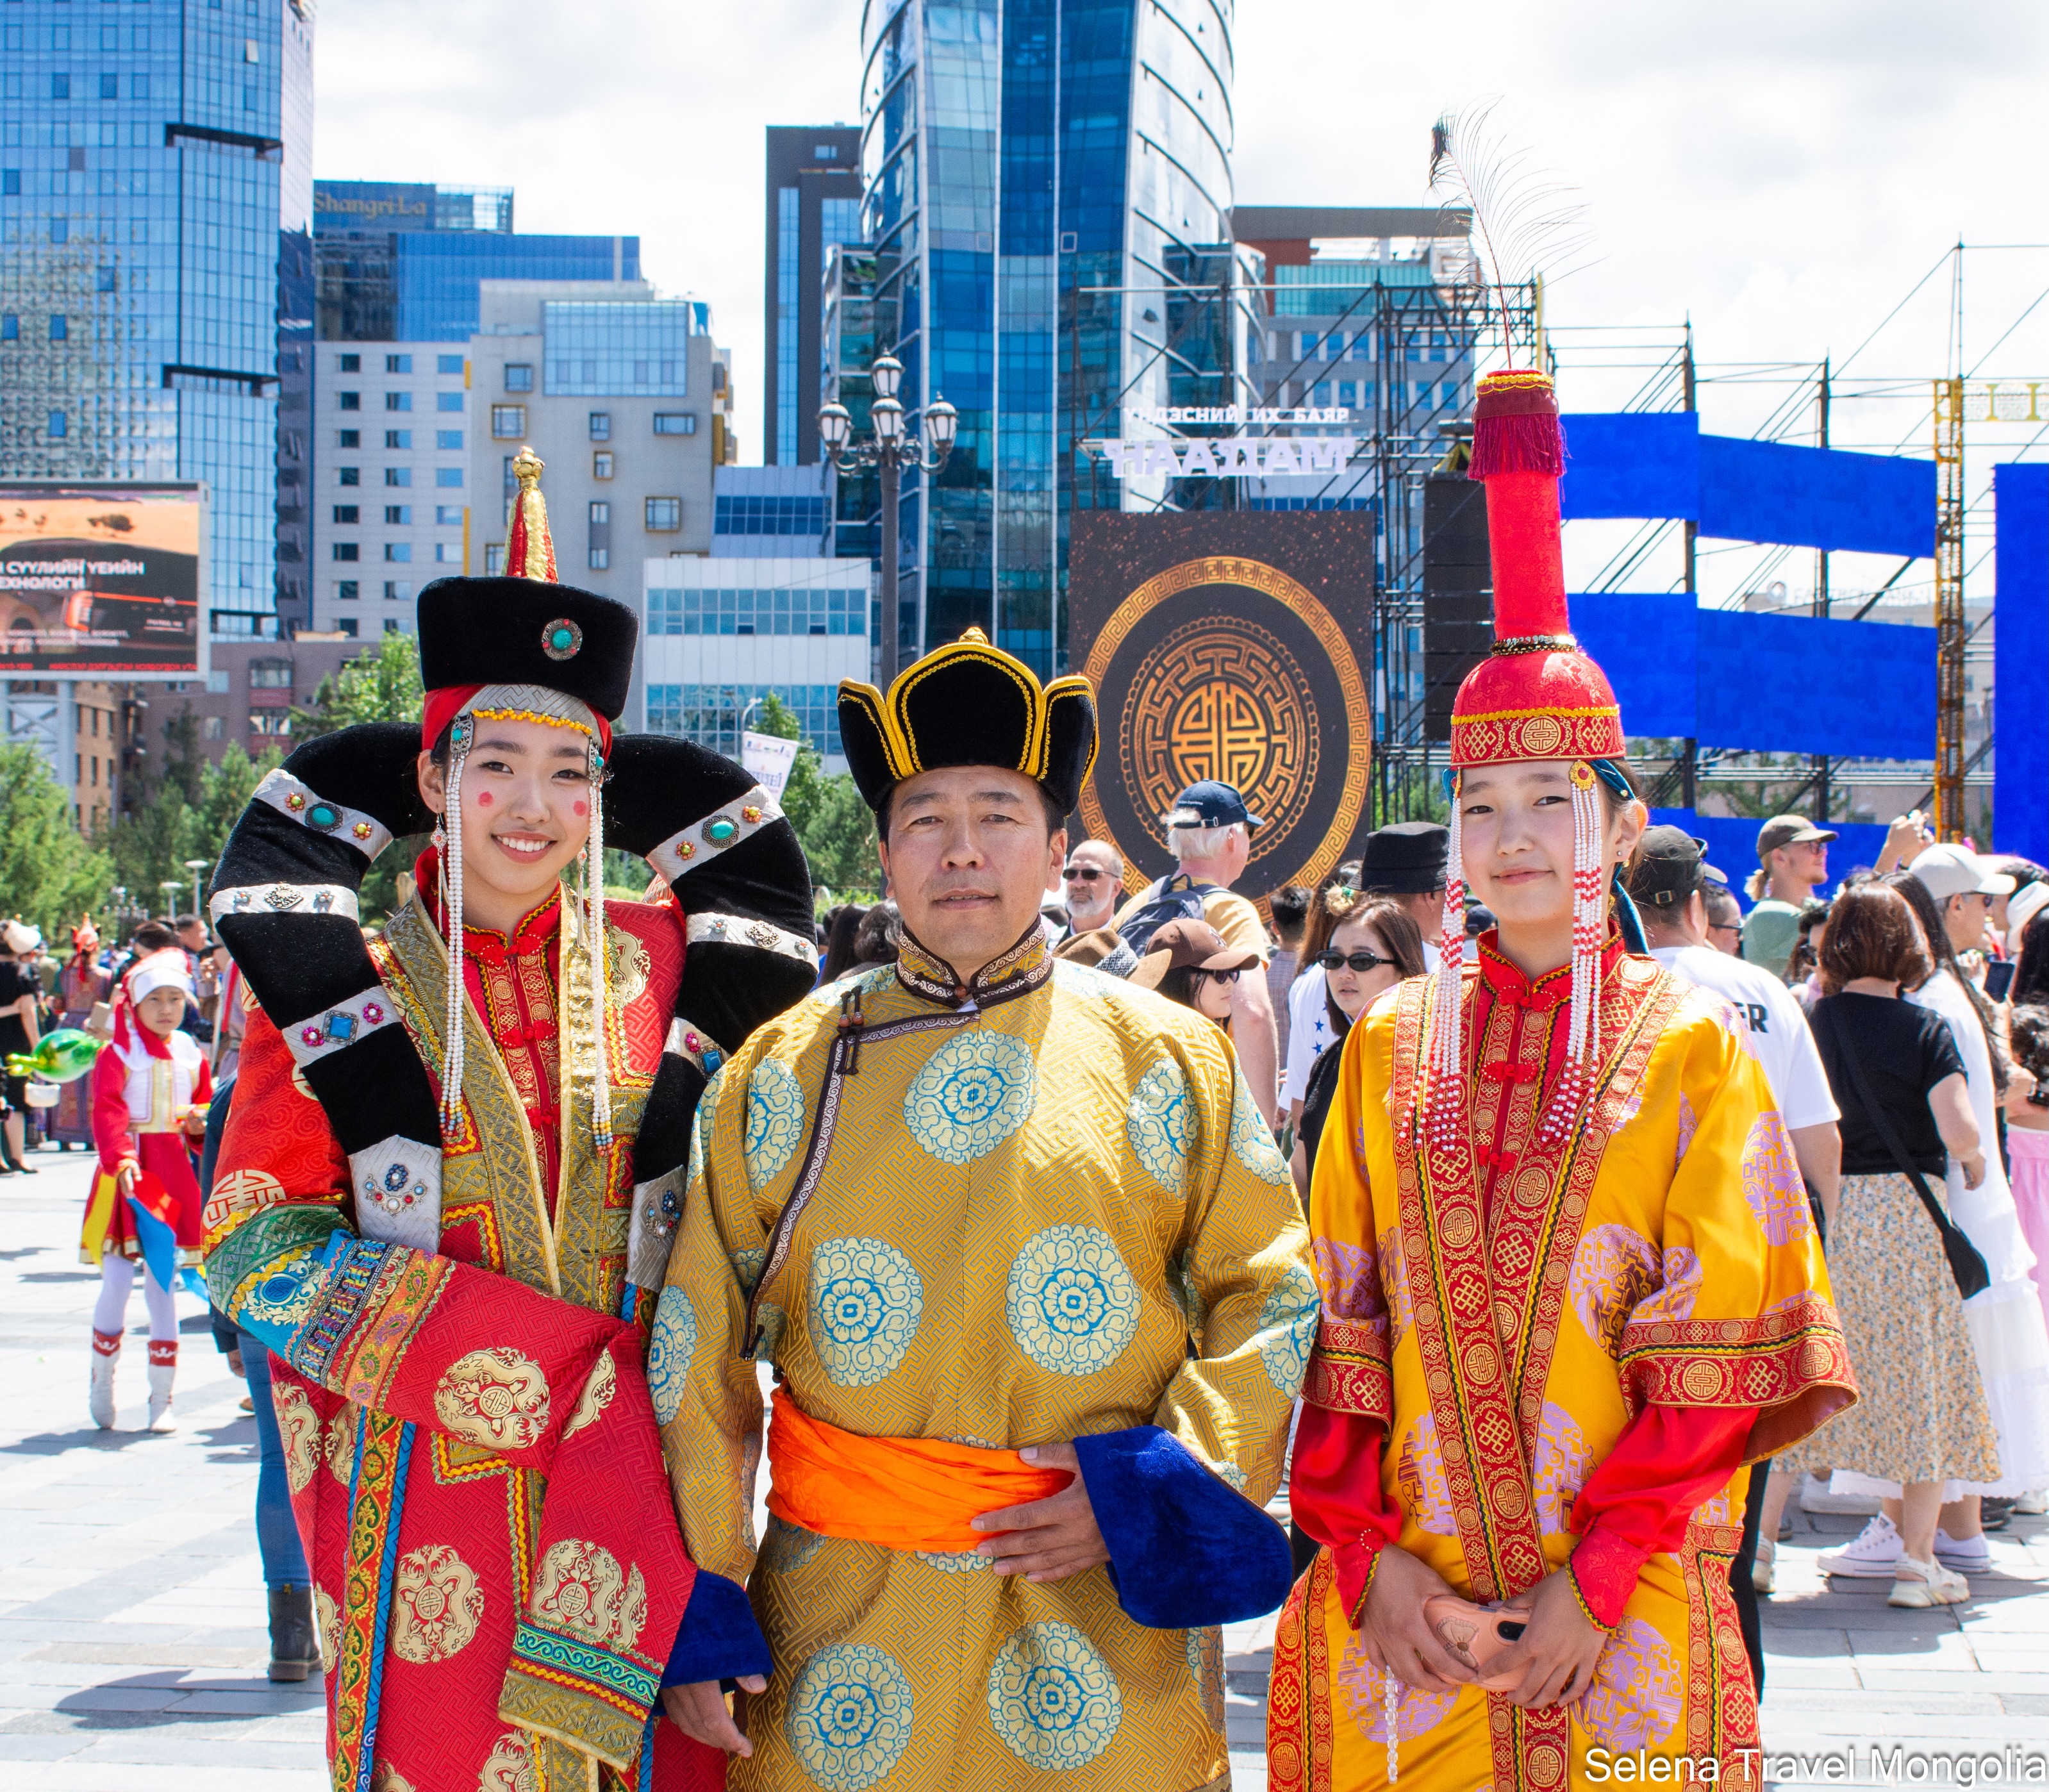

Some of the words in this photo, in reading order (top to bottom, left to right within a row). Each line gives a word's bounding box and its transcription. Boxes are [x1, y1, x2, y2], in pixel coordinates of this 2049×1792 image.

[1252, 408, 1282, 423] ИХ
[1294, 408, 1349, 423] БАЯР
[1103, 437, 1356, 480] НААДАМ
